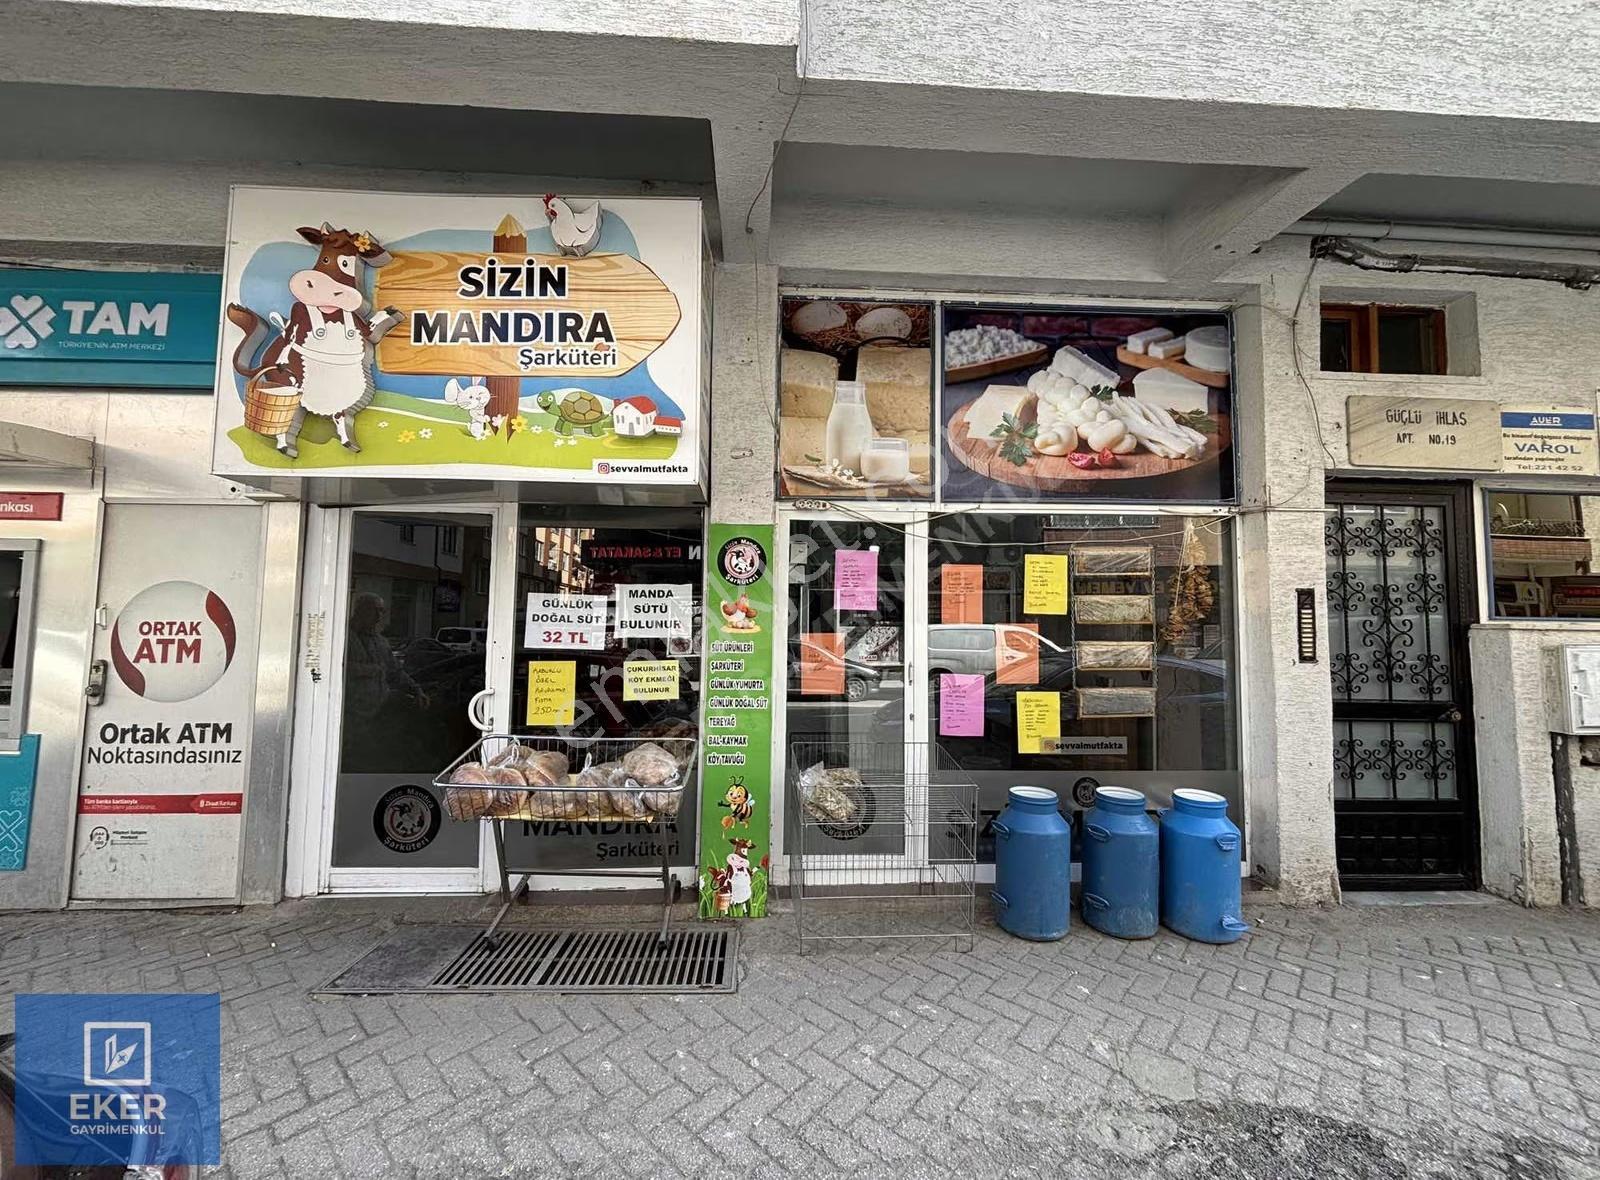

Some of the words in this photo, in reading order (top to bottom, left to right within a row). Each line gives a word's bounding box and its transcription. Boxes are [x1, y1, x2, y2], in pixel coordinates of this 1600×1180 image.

[460, 259, 566, 297] SİZİN
[62, 301, 170, 336] TAM
[412, 311, 615, 343] MANDIRA
[111, 342, 129, 350] ATM
[519, 349, 617, 370] Şarküteri
[1386, 408, 1423, 425] GÜÇLÜ
[1531, 416, 1561, 425] AUER
[1396, 433, 1415, 445] APT.
[1514, 442, 1581, 455] VAROL
[610, 463, 689, 475] sevvalmutfakta
[629, 589, 674, 599] MANDA
[634, 603, 668, 614] SÜTÜ
[532, 612, 574, 624] DOĞAL
[139, 621, 202, 636] ORTAK
[620, 619, 682, 630] BULUNUR
[542, 630, 562, 643] 32
[568, 631, 589, 644] TL
[132, 638, 202, 664] ATM
[711, 642, 724, 653] SÜT
[724, 641, 754, 653] ÜRÜNLERİ
[626, 665, 677, 674] ÇUKURHİSAR
[710, 661, 744, 673] ŞARKÜTERİ
[628, 676, 644, 684] KÖY
[645, 675, 676, 684] EKMEĞİ
[710, 679, 734, 690] GÜNLÜK
[735, 680, 764, 691] YUMURTA
[633, 686, 670, 695] BULUNUR
[709, 697, 734, 708] GÜNLÜK
[734, 697, 756, 709] DOĞAL
[756, 698, 768, 709] SÜT
[708, 716, 736, 727] TEREYAĞ
[100, 722, 170, 745] Ortak
[176, 722, 233, 745] ATM
[707, 735, 748, 746] BAL-KAYMAK
[1054, 740, 1124, 752] sevvalmutfakta
[87, 746, 242, 765] Noktasındasınız
[707, 753, 721, 765] KÖY
[721, 753, 745, 765] TAVUĞU
[596, 841, 679, 860] Şarküteri
